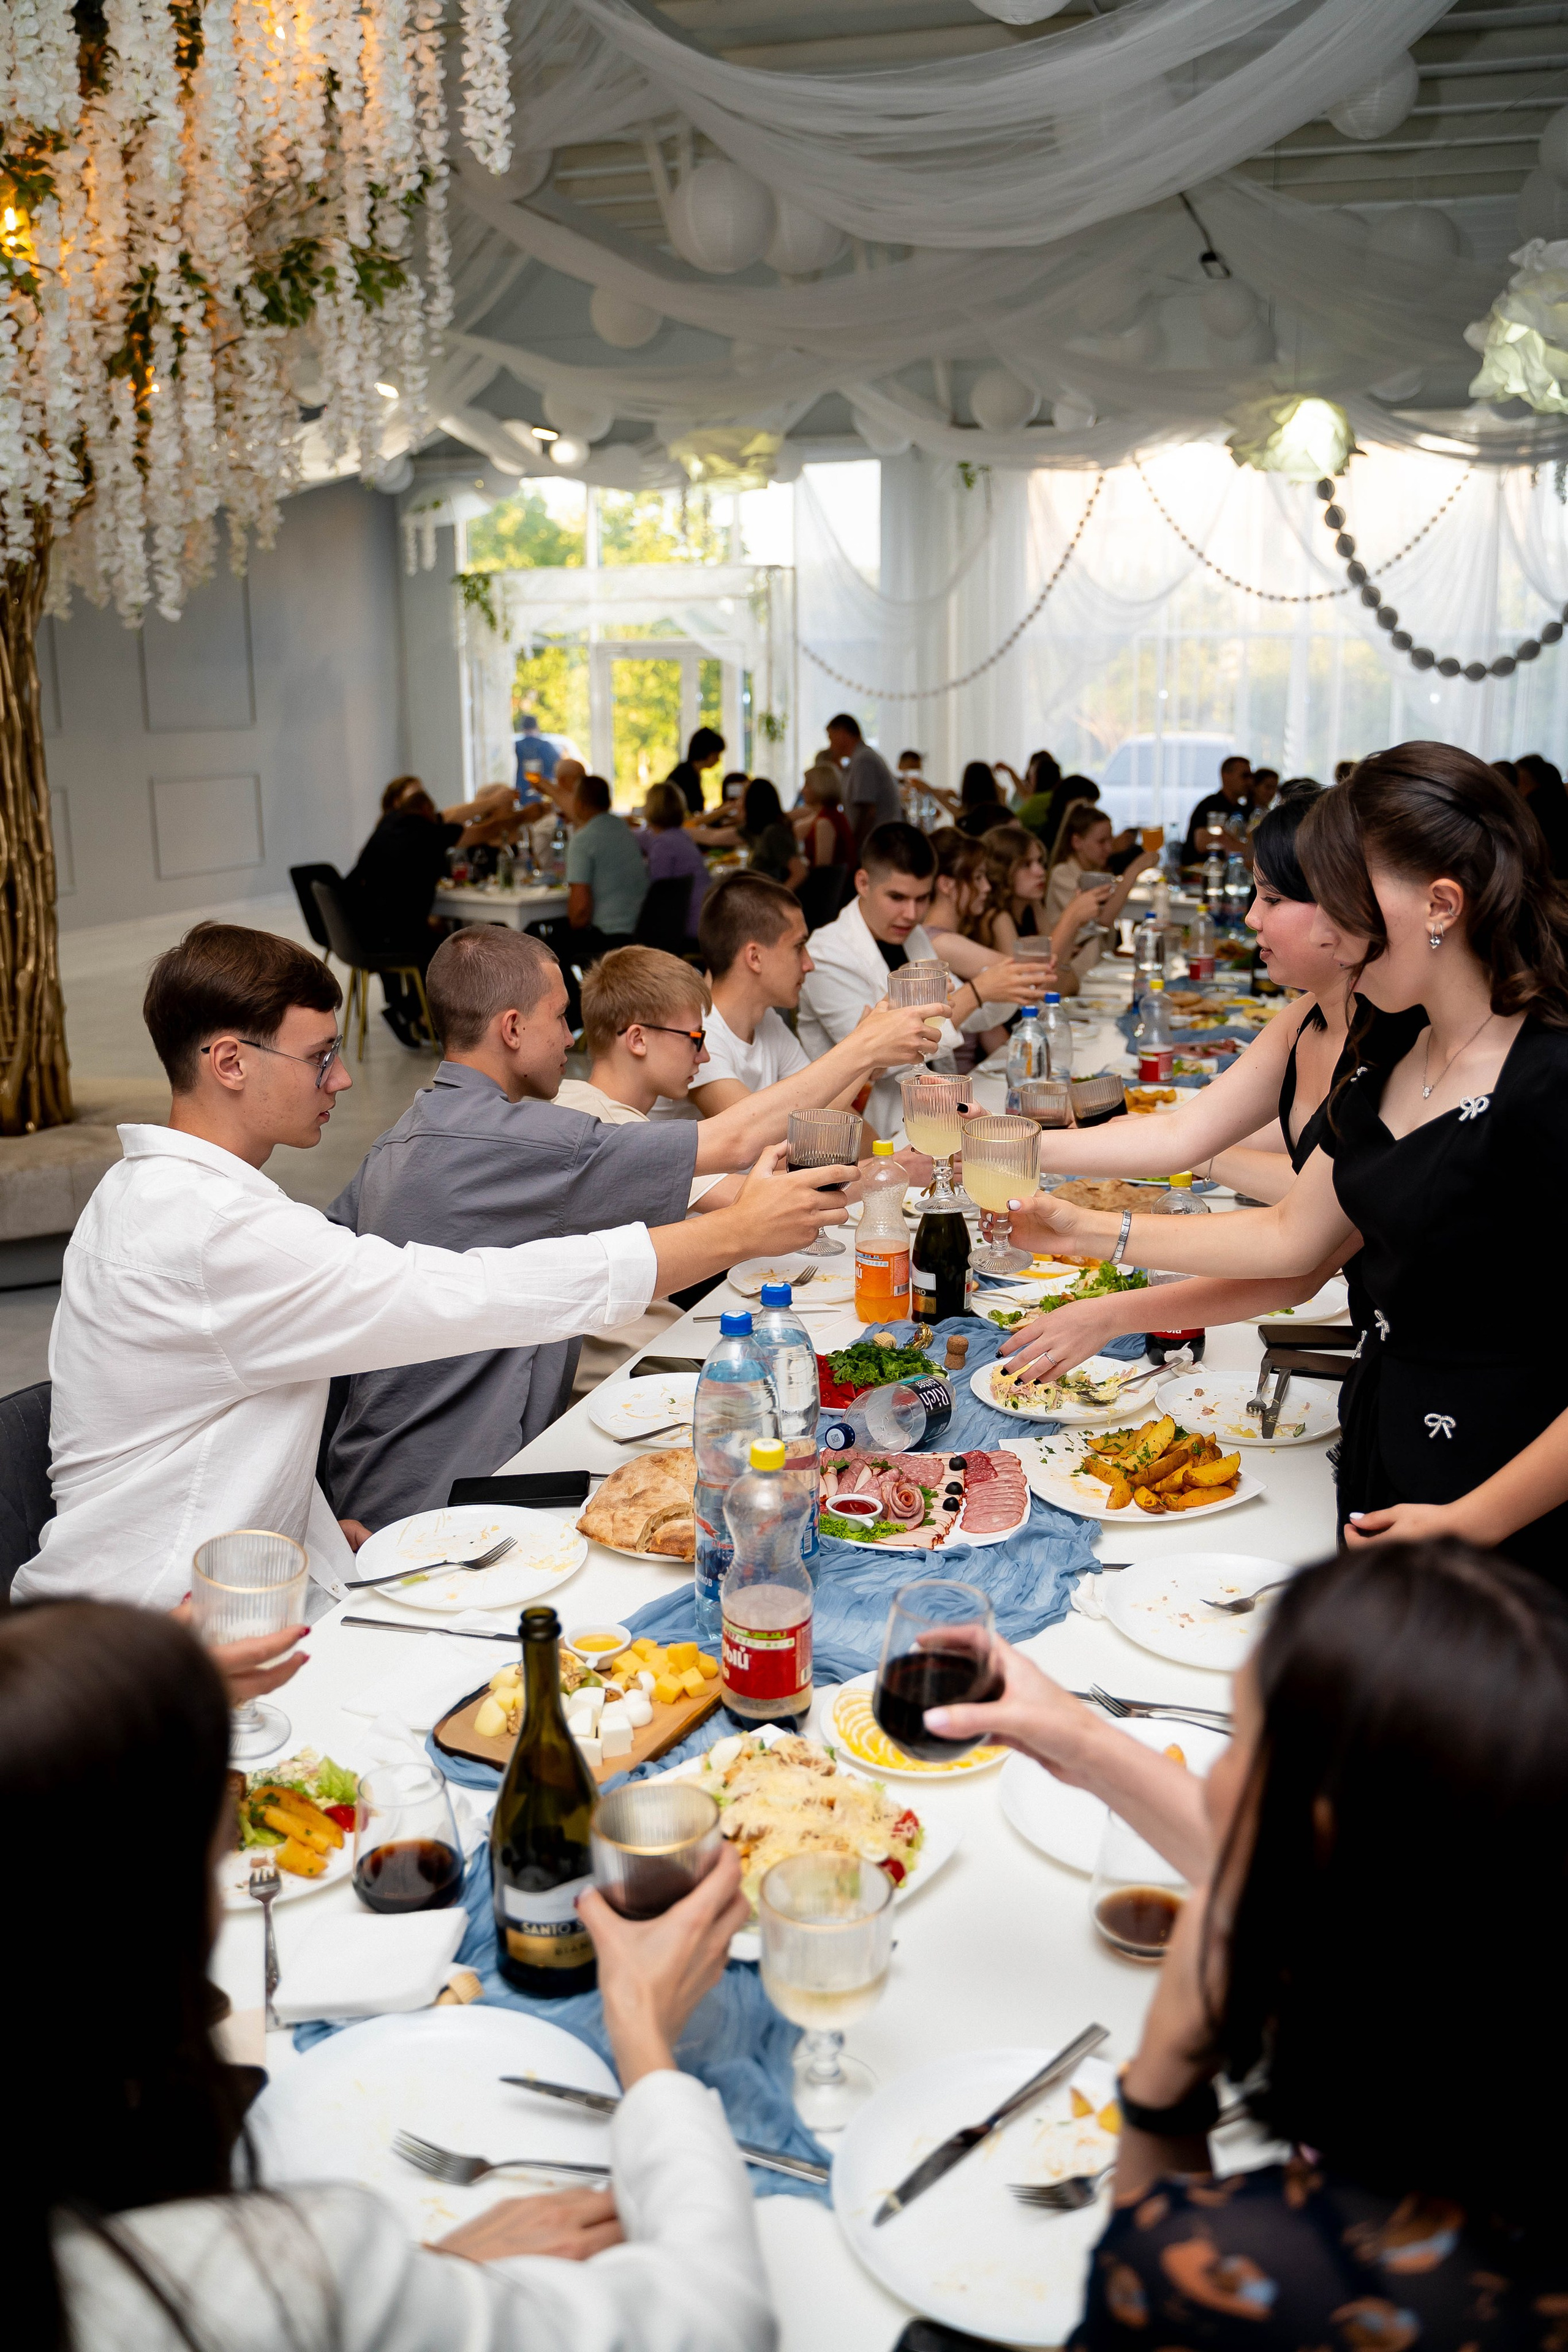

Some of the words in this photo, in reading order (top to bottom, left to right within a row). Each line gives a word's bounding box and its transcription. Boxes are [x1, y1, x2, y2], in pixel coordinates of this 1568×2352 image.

[915, 1378, 940, 1389] bitter
[919, 1386, 950, 1411] Rich
[522, 1921, 571, 1935] SANTO
